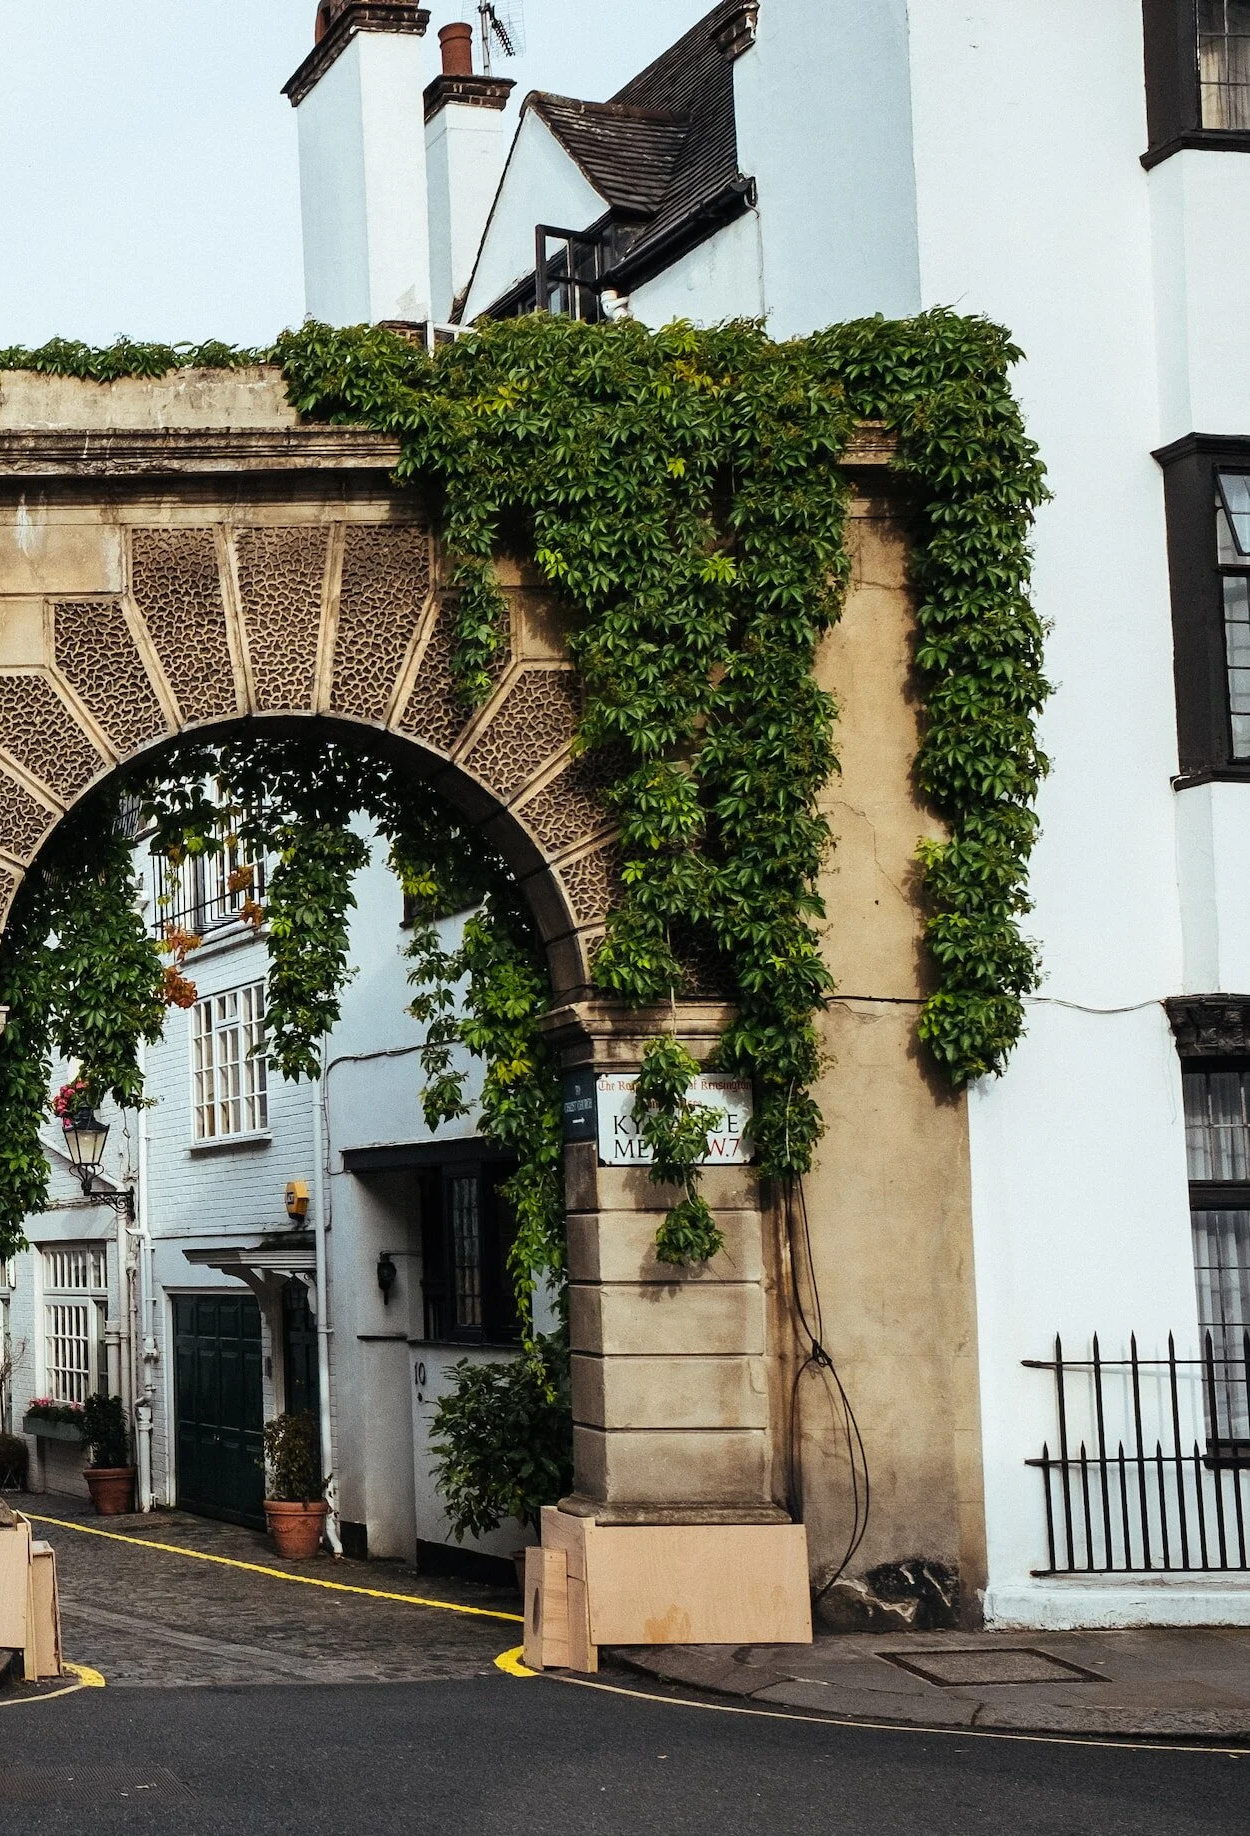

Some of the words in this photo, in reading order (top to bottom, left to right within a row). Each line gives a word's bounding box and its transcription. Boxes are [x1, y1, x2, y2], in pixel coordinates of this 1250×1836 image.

[598, 1080, 615, 1091] The
[617, 1080, 643, 1093] Roy
[701, 1079, 752, 1092] Kensington
[414, 1362, 426, 1386] 10
